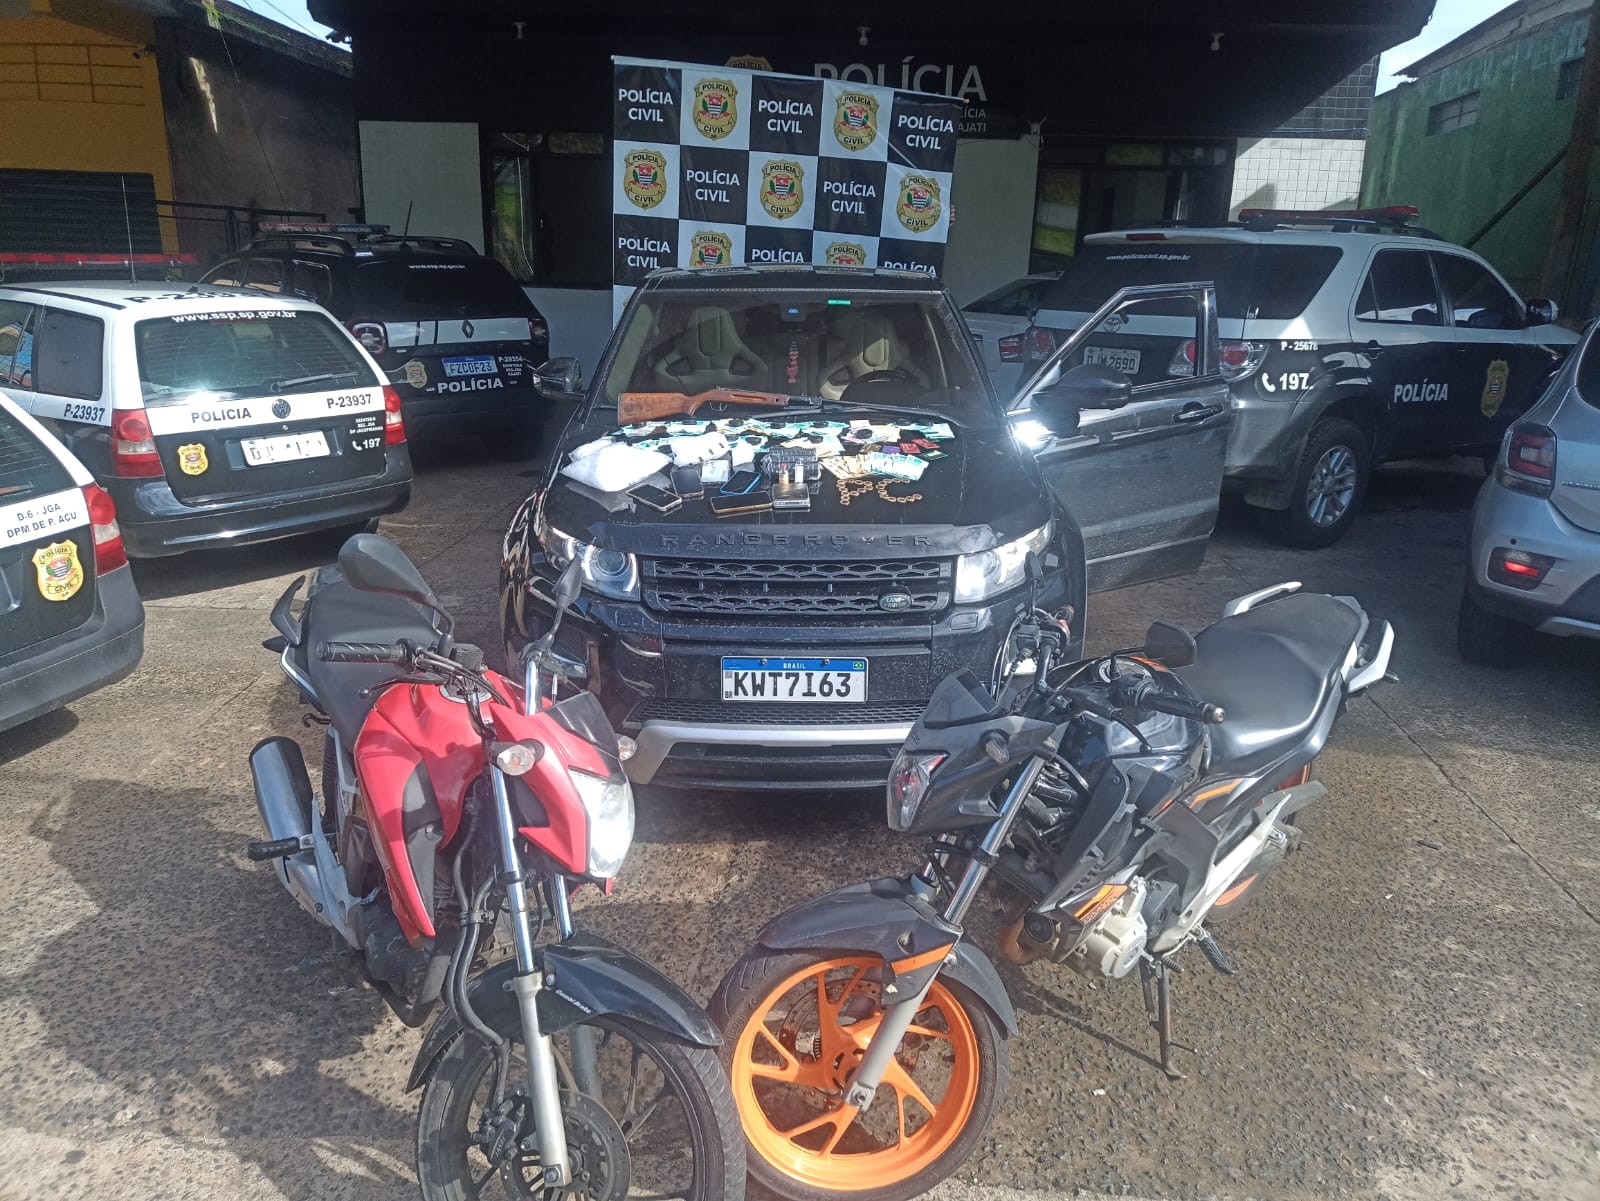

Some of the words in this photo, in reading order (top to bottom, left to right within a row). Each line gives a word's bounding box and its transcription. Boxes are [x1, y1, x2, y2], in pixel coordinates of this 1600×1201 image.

[618, 87, 673, 105] POLÍCIA
[628, 108, 664, 122] CIVIL
[758, 99, 814, 117] POLÍCIA
[703, 125, 725, 133] CIVIL
[767, 119, 804, 134] CIVIL
[897, 115, 954, 133] POLÍCIA
[843, 136, 865, 145] CIVIL
[906, 134, 942, 150] CIVIL
[686, 169, 740, 186] POLÍCIA
[695, 188, 730, 203] CIVIL
[823, 181, 876, 198] POLÍCIA
[634, 194, 656, 203] CIVIL
[770, 205, 792, 213] CIVIL
[831, 200, 865, 214] CIVIL
[906, 218, 928, 226] CIVIL
[618, 237, 671, 253] POLÍCIA
[627, 255, 661, 269] CIVIL
[751, 248, 804, 263] POLÍCIA
[884, 261, 937, 277] POLÍCIA
[171, 309, 297, 323] www.ssp.sp.gov.br
[437, 377, 504, 393] POLÍCIA
[1280, 372, 1309, 390] 197
[1394, 378, 1448, 403] POLÍCIA
[327, 394, 371, 408] P-23937
[64, 403, 105, 422] P-23937
[362, 437, 381, 448] 197
[42, 503, 61, 515] JGA
[7, 525, 31, 538] DPM
[32, 520, 46, 531] DE
[661, 533, 792, 547] RANGE
[803, 534, 932, 547] ROVER
[734, 672, 851, 698] KWT7I63
